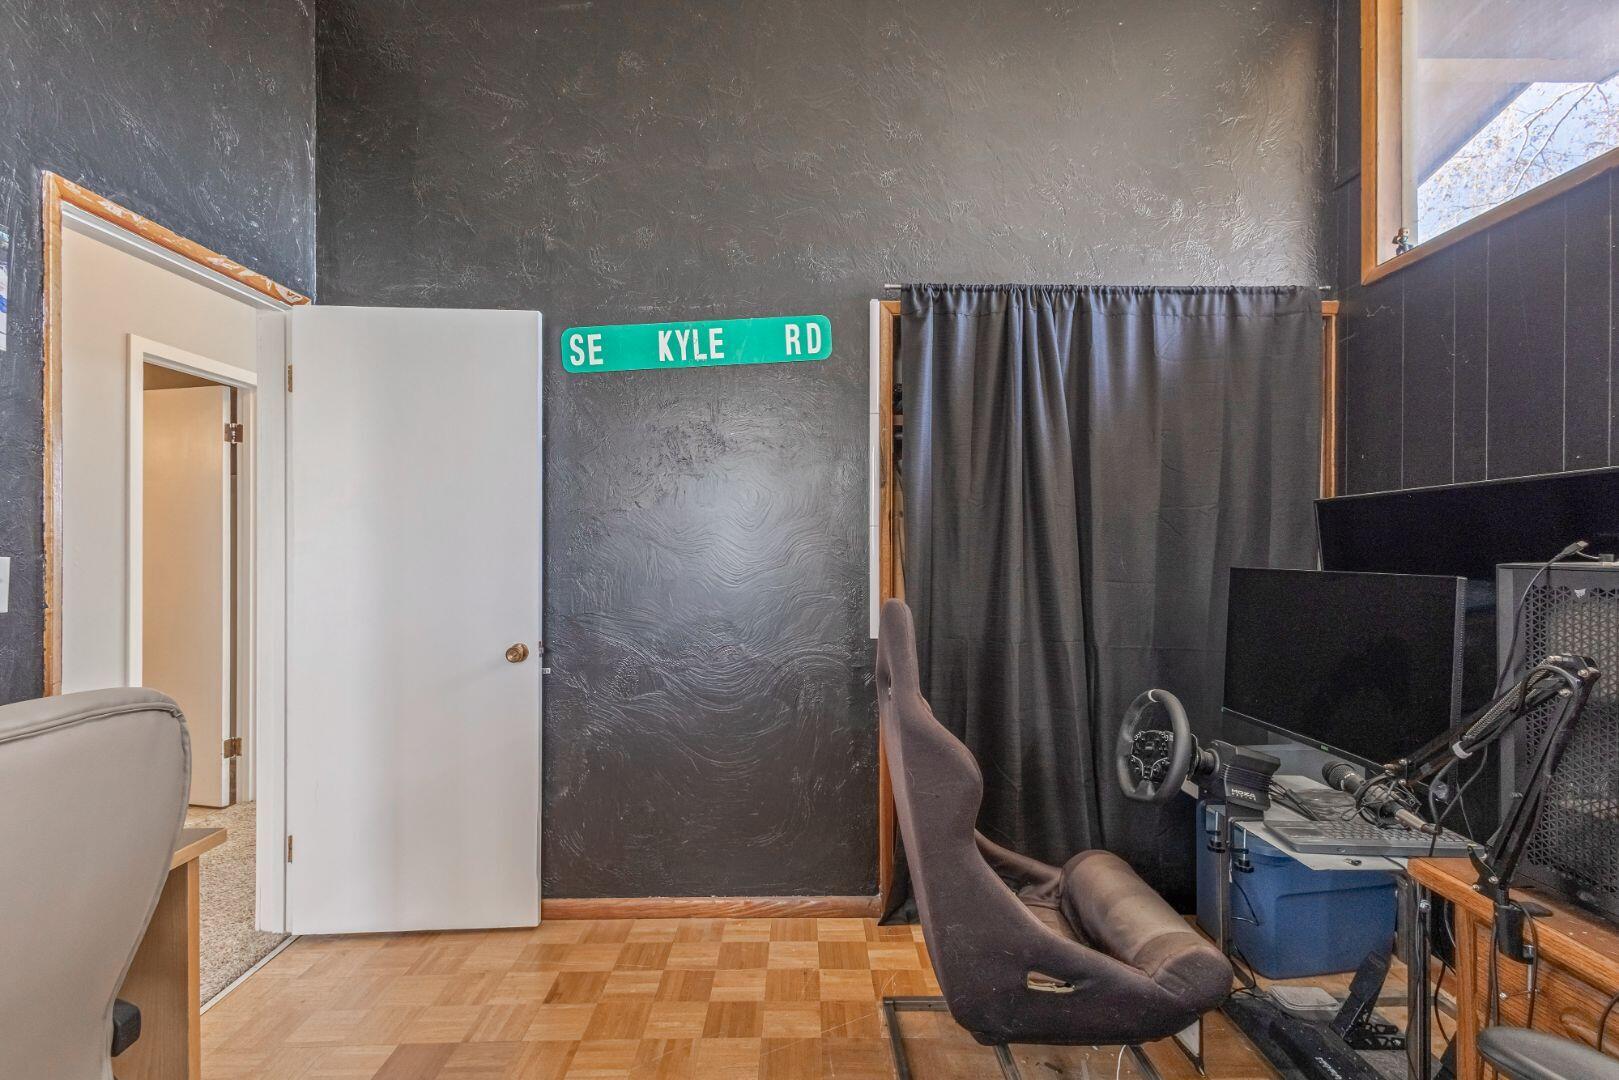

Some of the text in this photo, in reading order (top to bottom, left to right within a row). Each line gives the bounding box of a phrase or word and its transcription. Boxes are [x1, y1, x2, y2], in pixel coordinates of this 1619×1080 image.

[569, 322, 822, 366] SE KYLE RD
